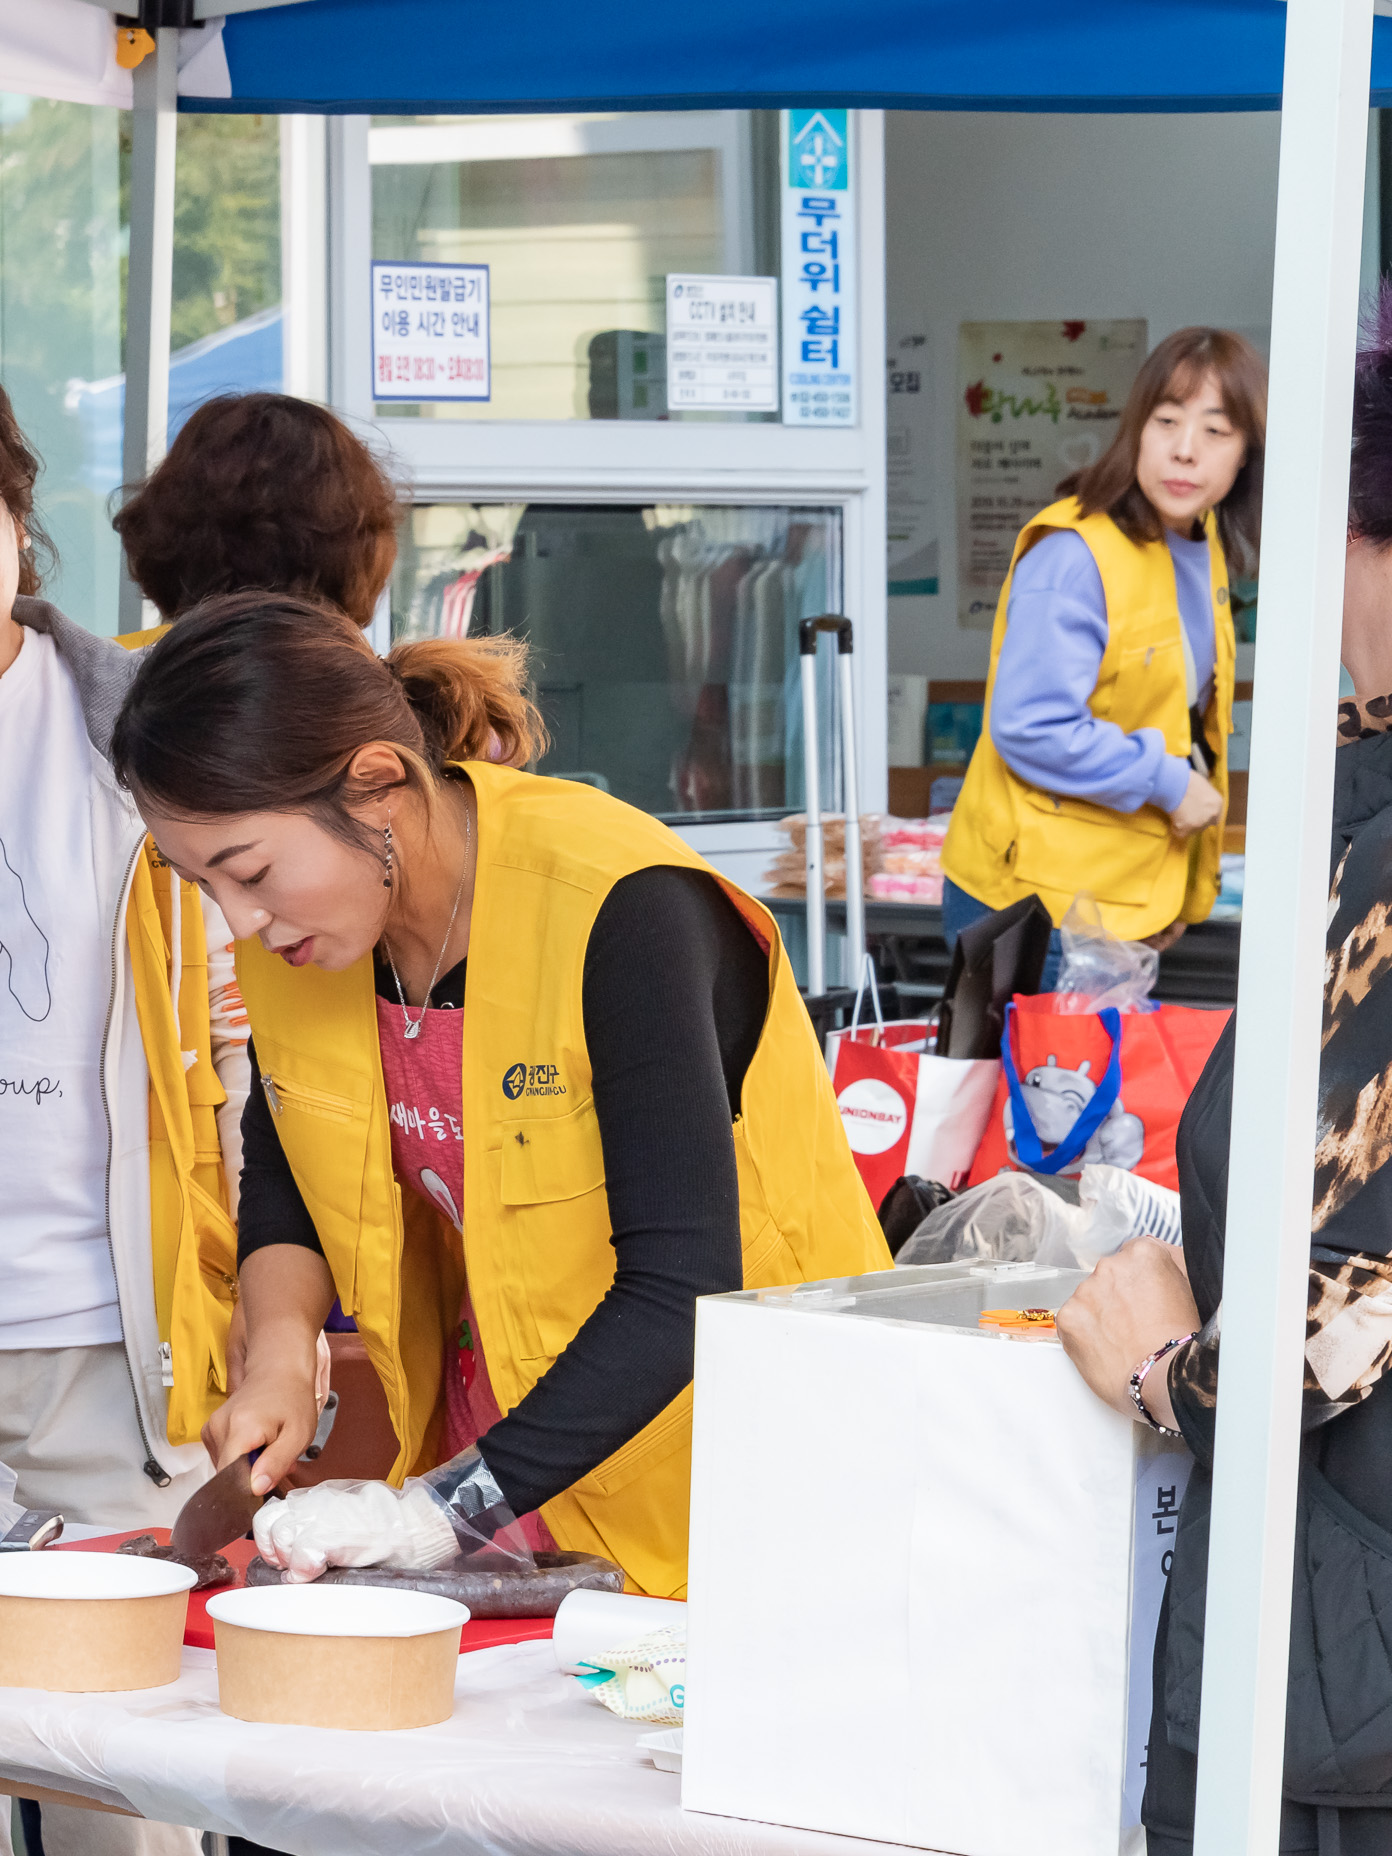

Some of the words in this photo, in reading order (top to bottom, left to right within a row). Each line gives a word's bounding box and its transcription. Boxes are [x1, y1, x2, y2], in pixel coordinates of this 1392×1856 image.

[796, 197, 841, 294] 무더위
[379, 274, 482, 303] 무인민원발급기
[381, 309, 411, 338] 이용
[416, 310, 446, 338] 시간
[451, 310, 481, 338] 안내
[799, 305, 840, 369] 쉼터
[528, 1064, 560, 1087] 광진구
[839, 1106, 903, 1124] UNIONBAY
